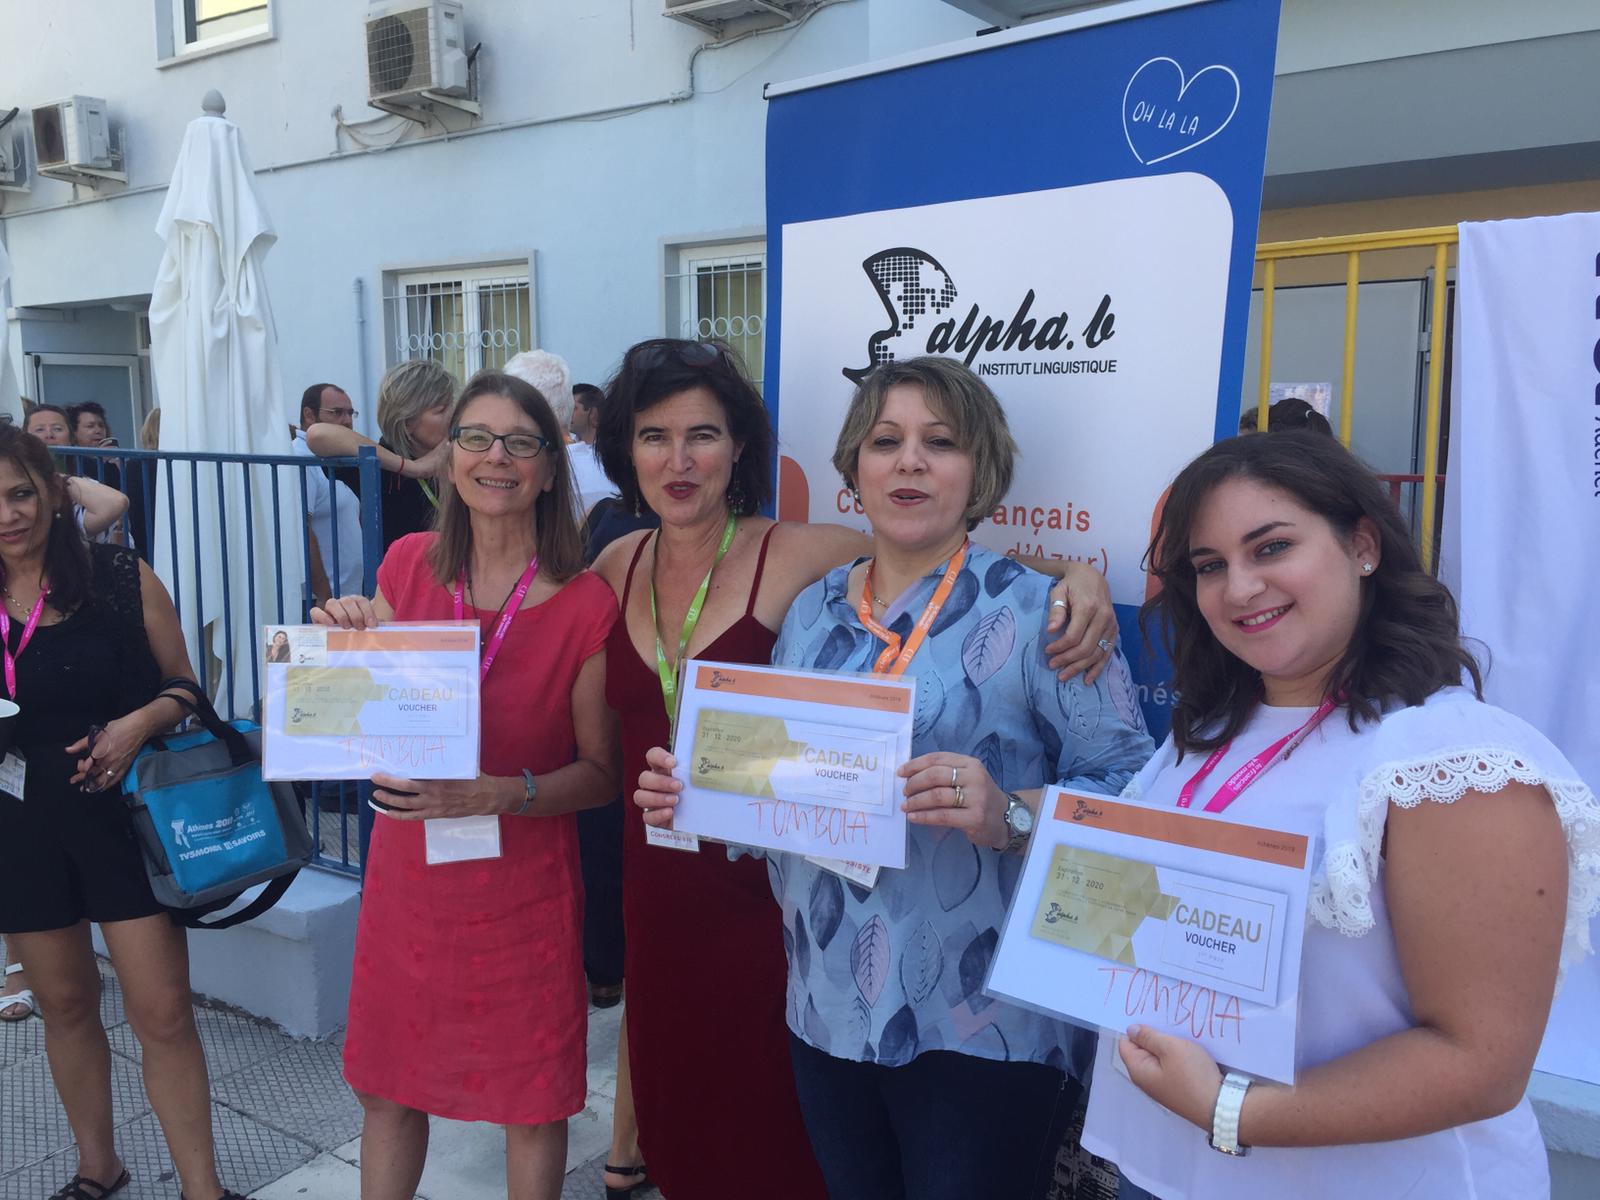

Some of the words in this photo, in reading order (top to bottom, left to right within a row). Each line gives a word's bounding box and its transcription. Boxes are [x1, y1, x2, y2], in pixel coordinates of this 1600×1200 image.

[1132, 101, 1156, 122] OH
[1158, 109, 1176, 130] LA
[1179, 115, 1200, 136] LA
[926, 288, 1116, 368] alpha.b
[978, 361, 1031, 376] INSTITUT
[1032, 359, 1118, 375] LINGUISTIQUE
[990, 502, 1092, 537] ançais
[387, 687, 455, 702] CADEAU
[397, 703, 438, 713] VOUCHER
[804, 746, 879, 772] CADEAU
[815, 768, 860, 783] VOUCHER
[1086, 880, 1105, 891] 2020
[1175, 903, 1263, 944] CADEAU
[1185, 931, 1237, 956] VOUCHER
